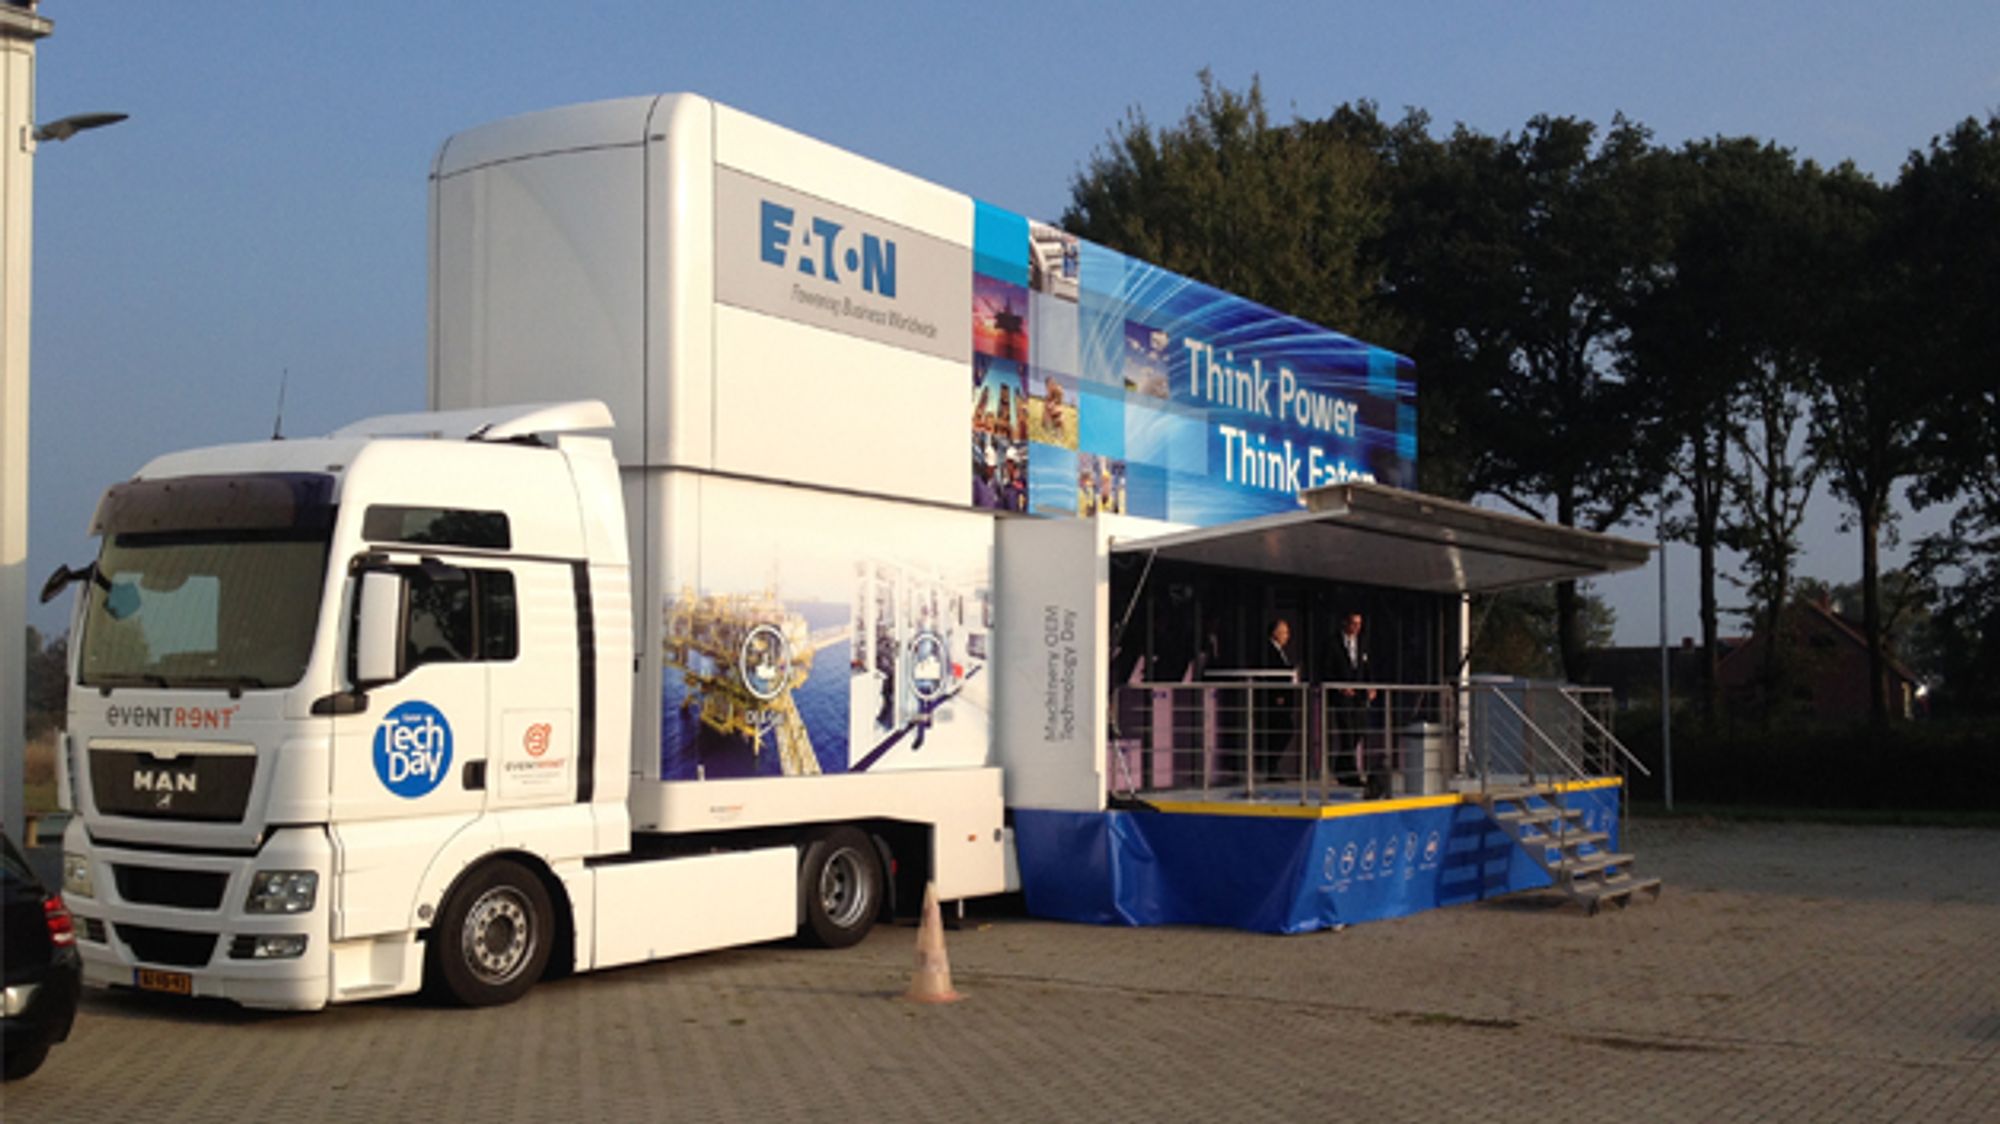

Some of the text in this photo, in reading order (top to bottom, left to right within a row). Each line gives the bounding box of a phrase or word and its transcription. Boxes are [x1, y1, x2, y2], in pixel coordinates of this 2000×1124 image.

[761, 199, 896, 299] EATON
[1184, 337, 1359, 437] Think Power
[1219, 424, 1301, 494] Think
[1044, 605, 1060, 743] Machinery OEM
[1061, 609, 1078, 740] Technology Day
[380, 716, 444, 753] Tech
[389, 751, 442, 783] Day
[133, 770, 197, 792] MAN
